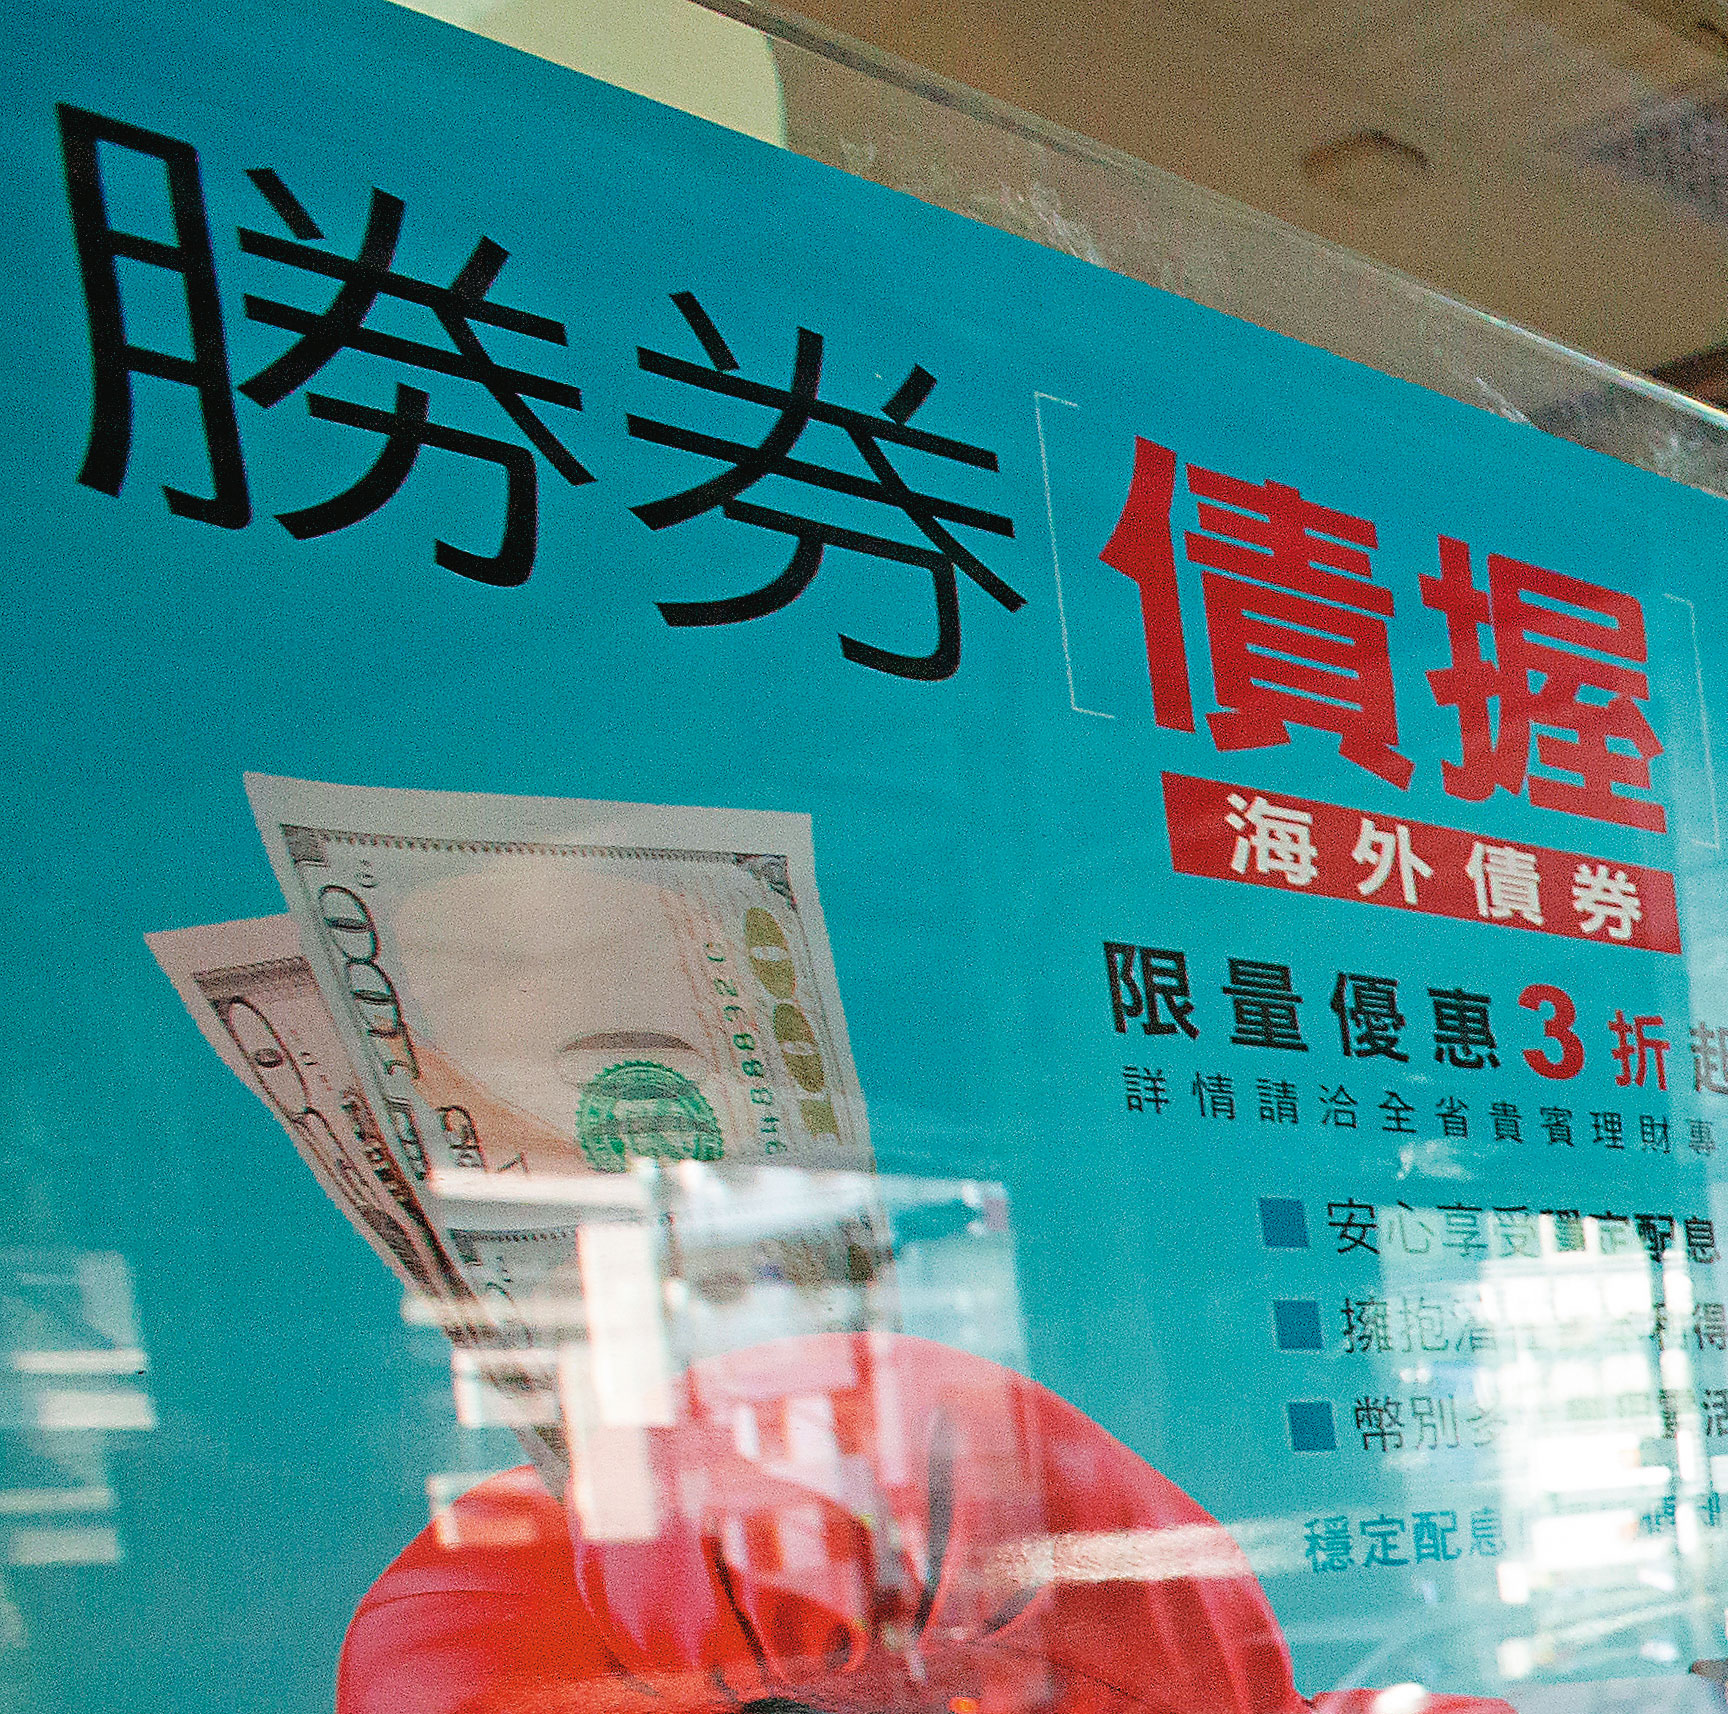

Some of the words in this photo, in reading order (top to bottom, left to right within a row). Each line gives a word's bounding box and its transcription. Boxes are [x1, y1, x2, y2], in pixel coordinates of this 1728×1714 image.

[56, 101, 1028, 682] 勝券
[1098, 435, 1667, 835] 債握
[1224, 792, 1643, 943] 海外債券
